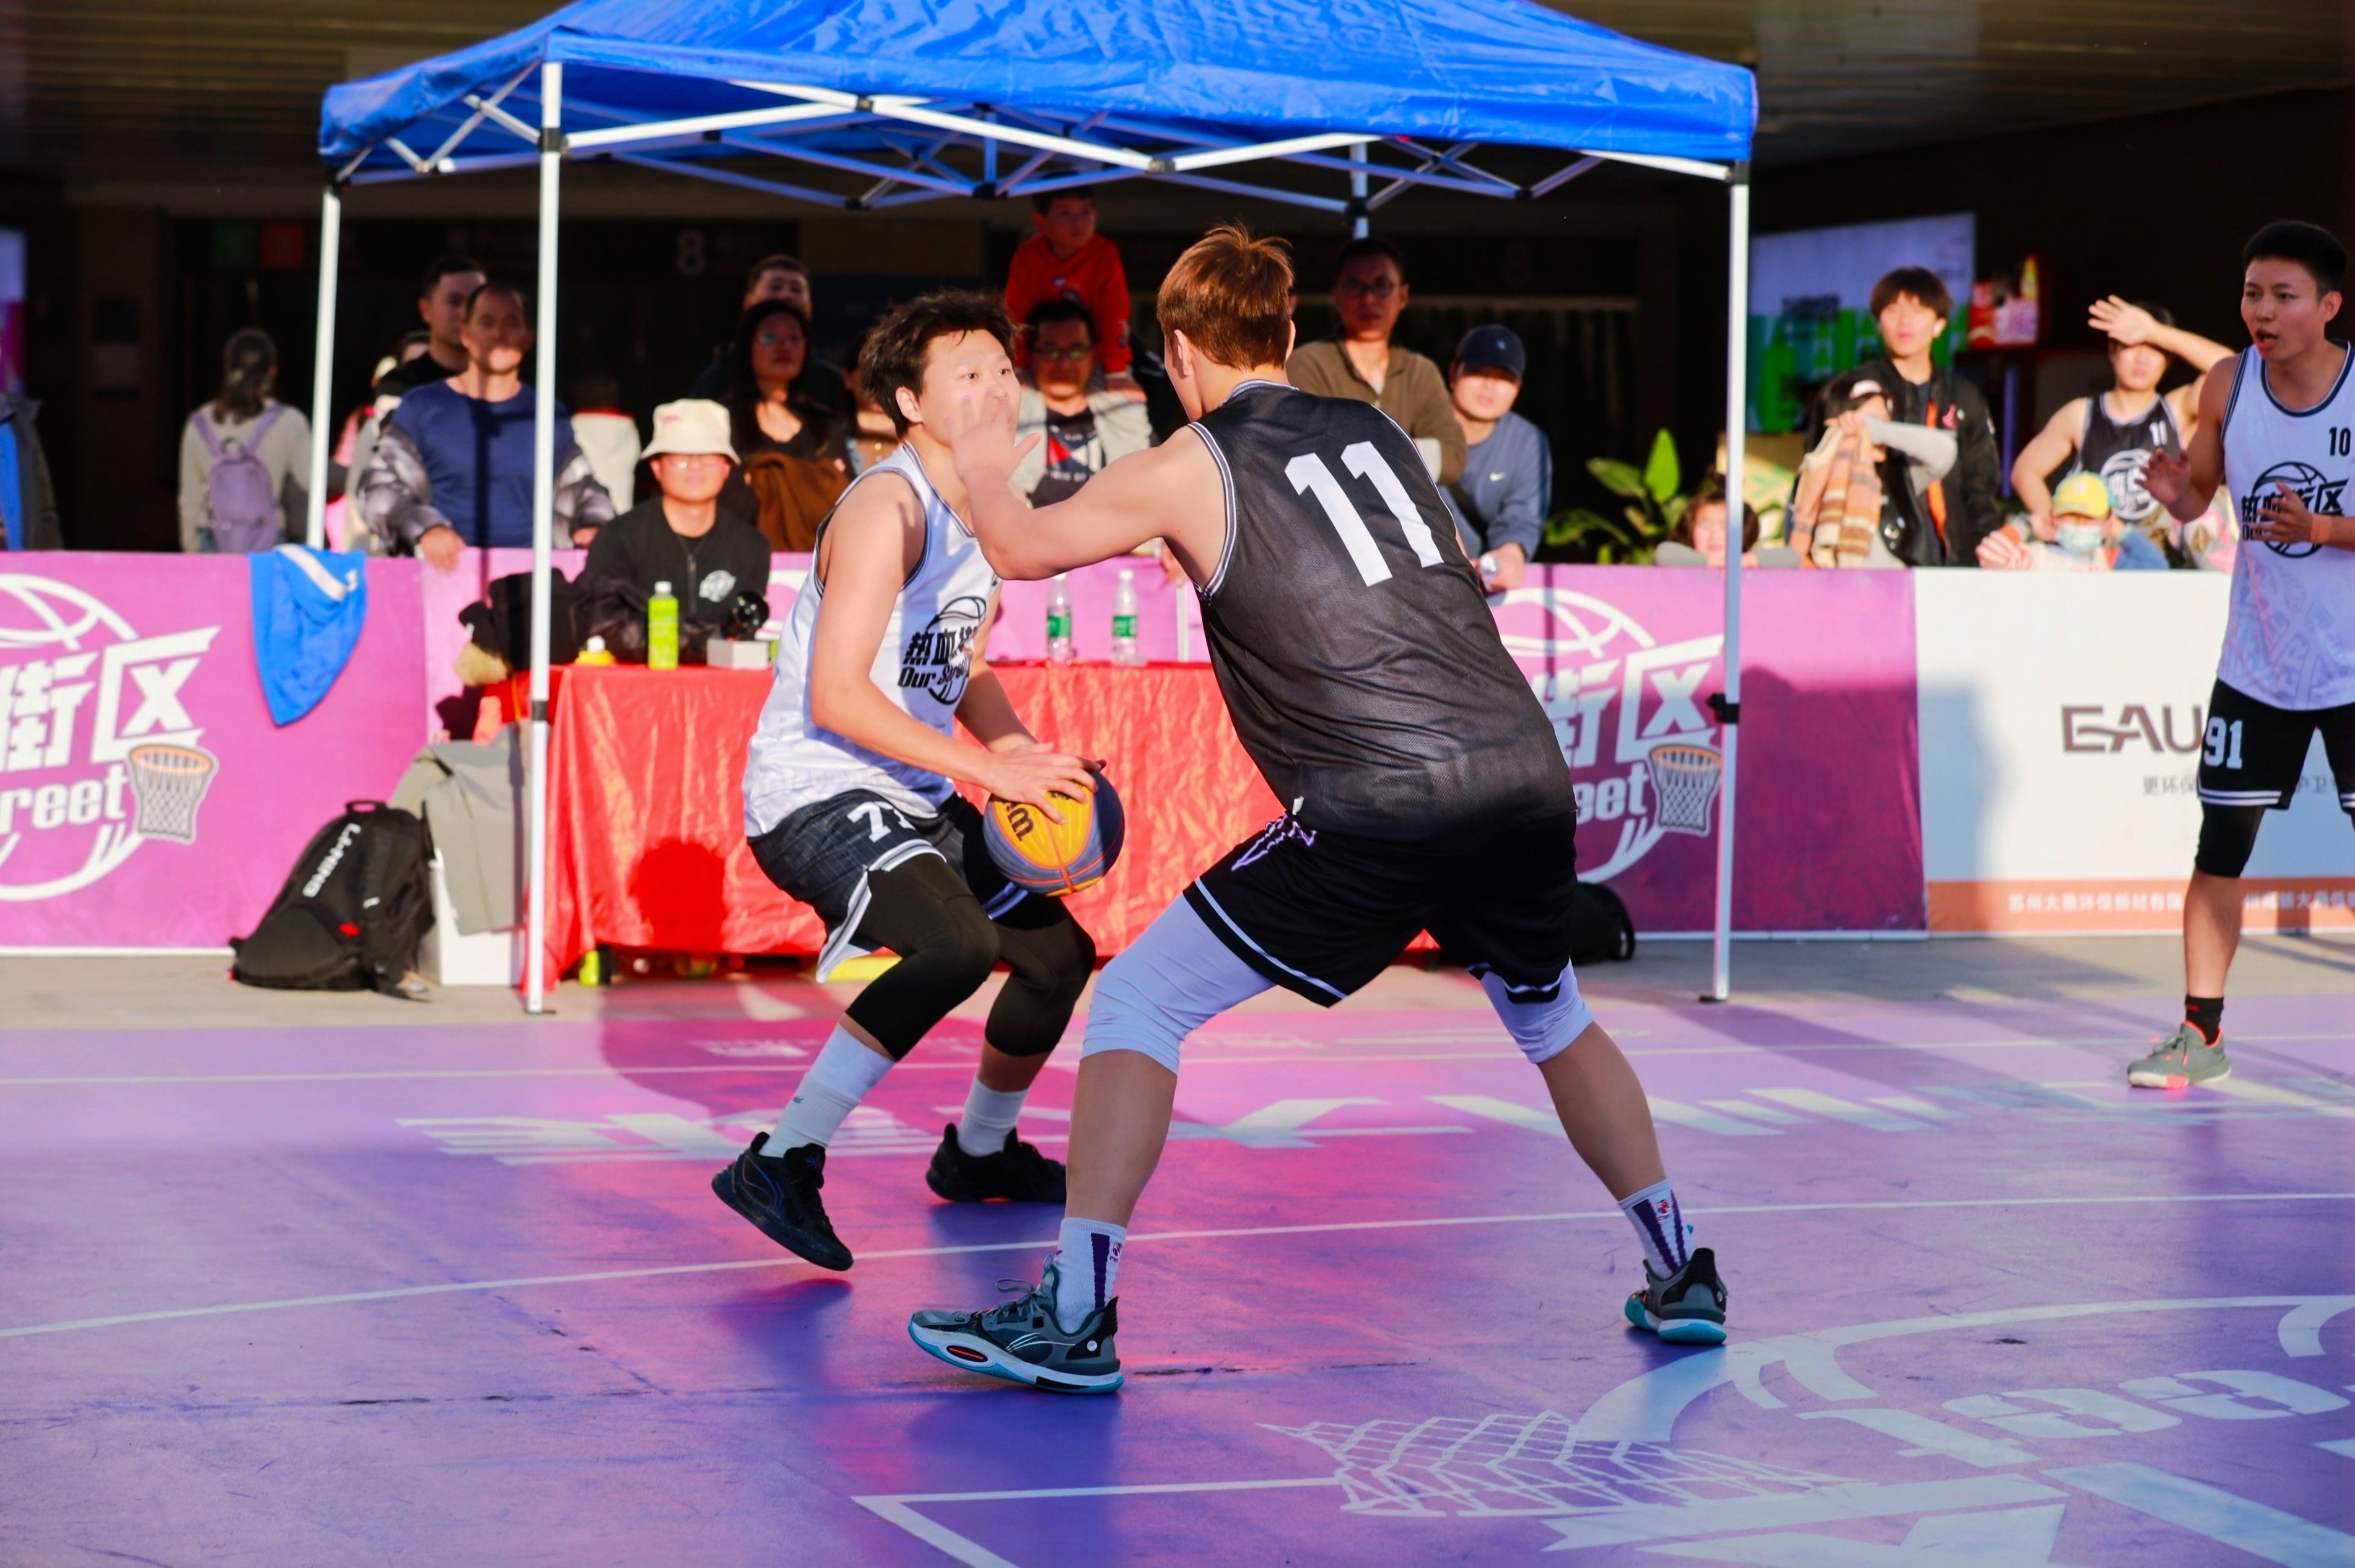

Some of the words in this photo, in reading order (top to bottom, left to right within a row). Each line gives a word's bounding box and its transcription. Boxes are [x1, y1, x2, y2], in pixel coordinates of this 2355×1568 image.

[2149, 420, 2168, 446] 11
[2329, 427, 2351, 456] 10
[1284, 440, 1445, 587] 11
[898, 666, 937, 688] Our
[2203, 716, 2243, 769] 91
